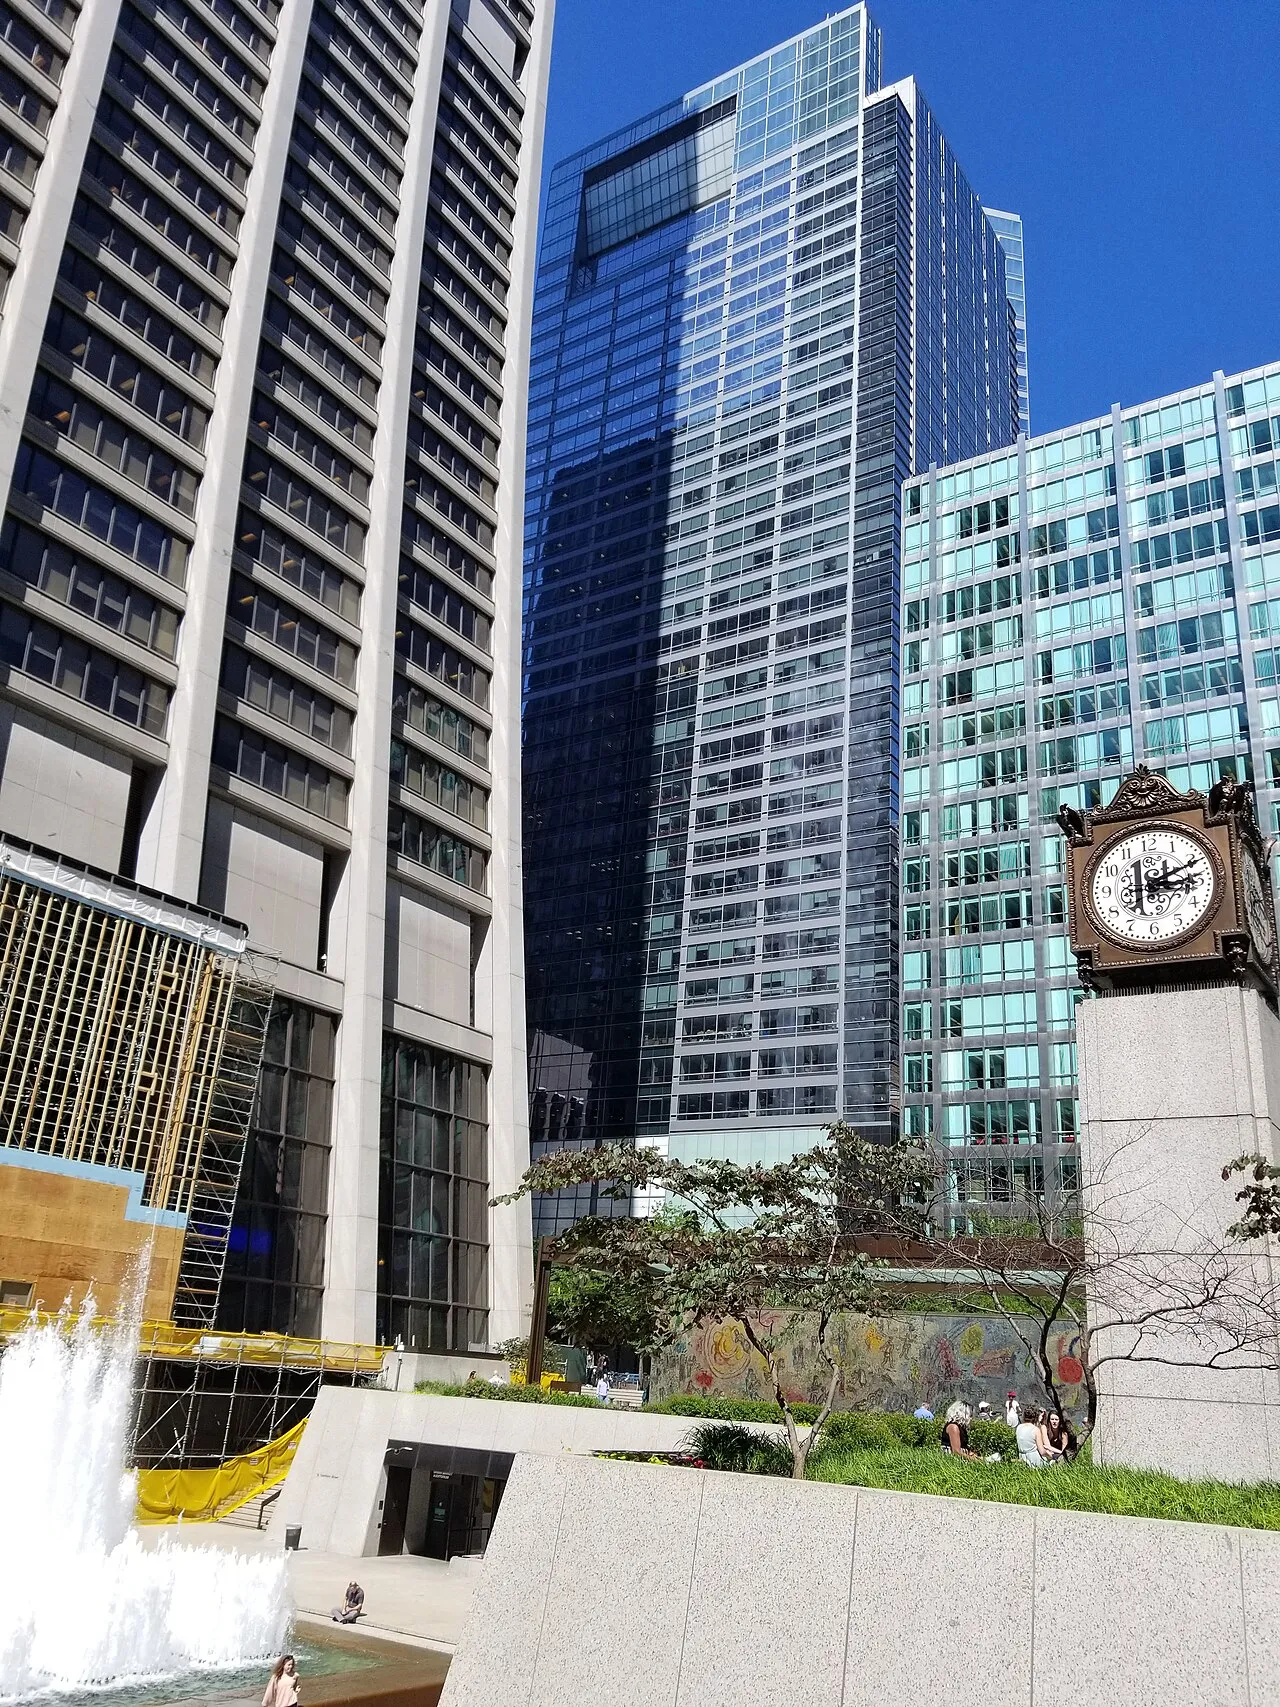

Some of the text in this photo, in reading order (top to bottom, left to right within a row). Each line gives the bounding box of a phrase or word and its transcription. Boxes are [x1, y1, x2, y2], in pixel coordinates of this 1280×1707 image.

[1142, 838, 1157, 852] 12
[1170, 841, 1176, 853] 1
[1122, 848, 1131, 860] 11
[1105, 864, 1118, 877] 10
[1102, 886, 1111, 898] 9
[1188, 896, 1200, 908] 4
[1108, 906, 1119, 918] 8
[1126, 919, 1135, 931] 7
[1174, 914, 1182, 926] 5
[1150, 922, 1159, 935] 6
